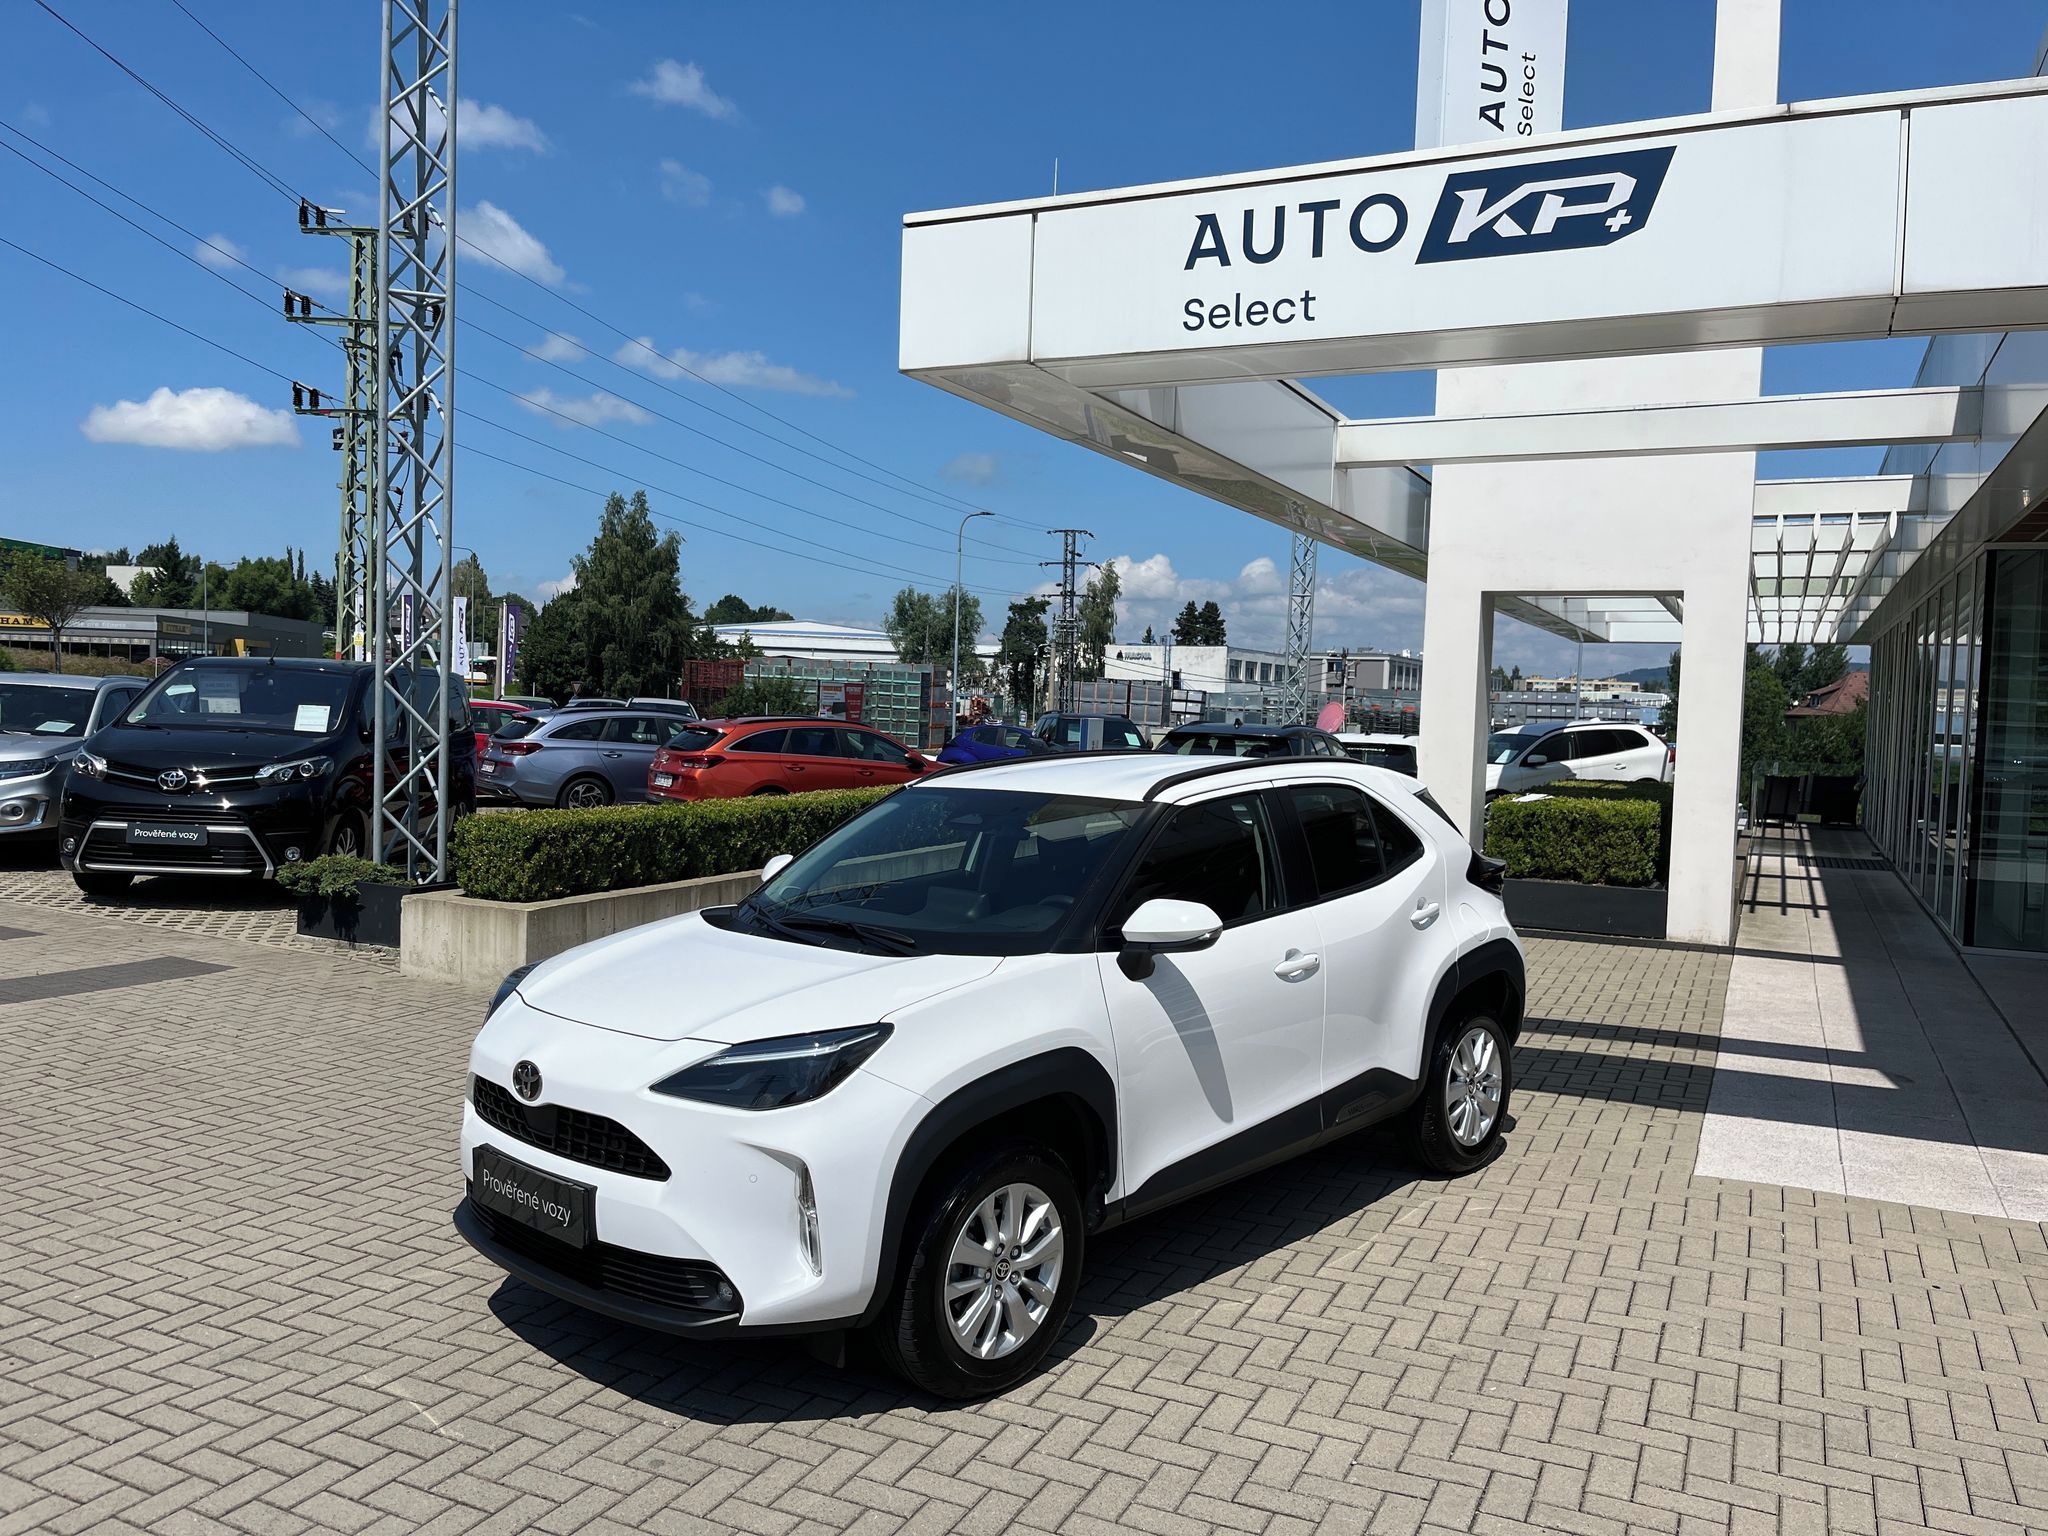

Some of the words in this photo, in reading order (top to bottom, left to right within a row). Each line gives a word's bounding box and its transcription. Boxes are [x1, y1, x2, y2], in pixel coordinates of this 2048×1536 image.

[1479, 0, 1511, 132] AUTO
[1517, 52, 1536, 136] Select
[1184, 193, 1409, 271] AUTO
[1182, 290, 1316, 331] Select
[134, 828, 177, 838] Prověřené
[178, 832, 199, 841] vozy
[483, 1168, 539, 1210] Prověřené
[542, 1199, 571, 1227] vozy
